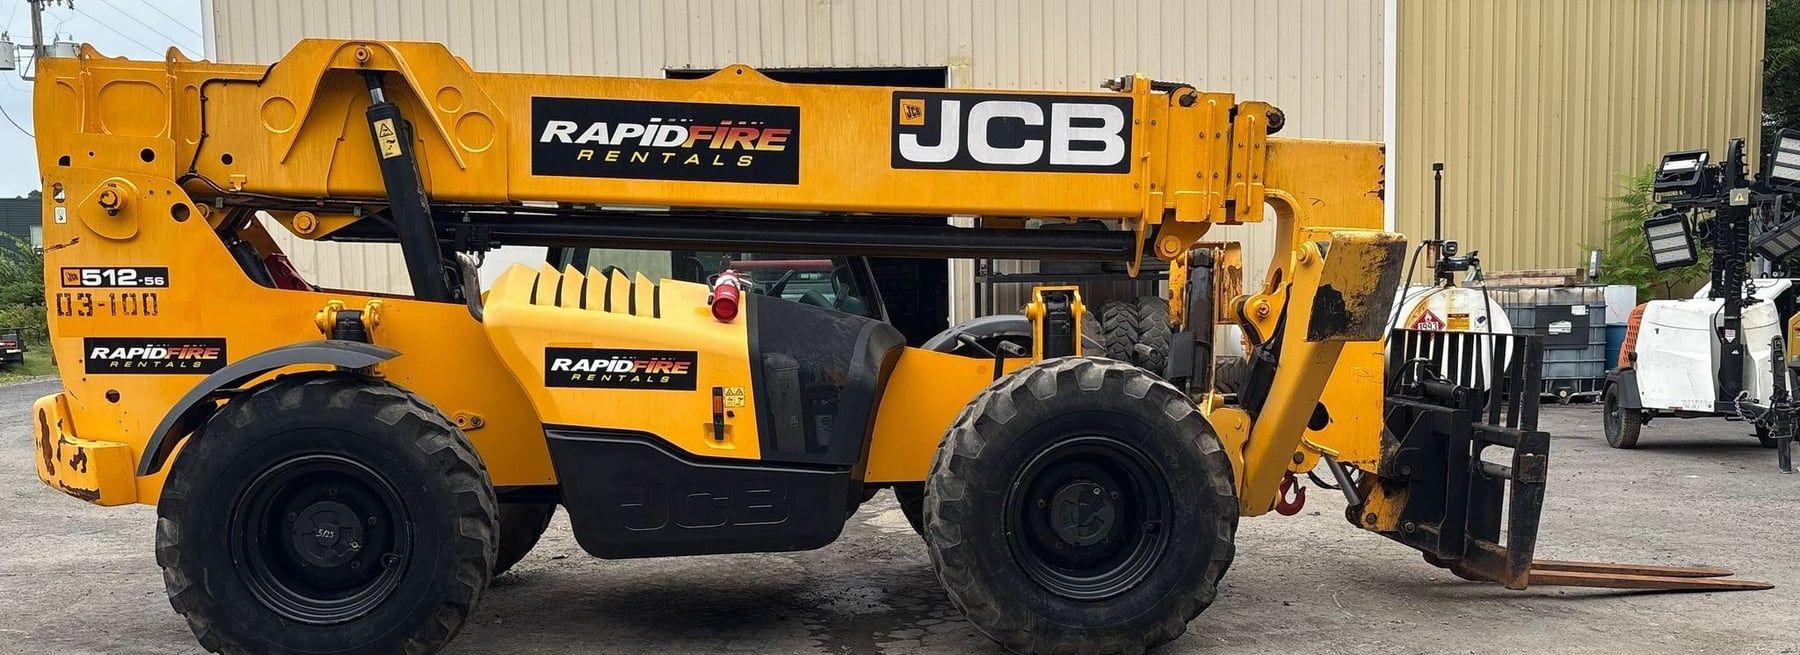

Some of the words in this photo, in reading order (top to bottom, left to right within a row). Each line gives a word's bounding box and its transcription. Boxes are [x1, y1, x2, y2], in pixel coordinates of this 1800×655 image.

[540, 118, 792, 151] RAPIDFIRE
[899, 100, 1125, 166] JCB
[577, 150, 753, 167] RENTALS
[82, 269, 165, 286] 512-56
[56, 293, 158, 316] 03-100
[90, 345, 221, 360] RAPIDFIRE
[551, 356, 691, 374] RAPIDFIRE
[571, 374, 670, 383] RENTALS
[619, 482, 791, 531] JCB
